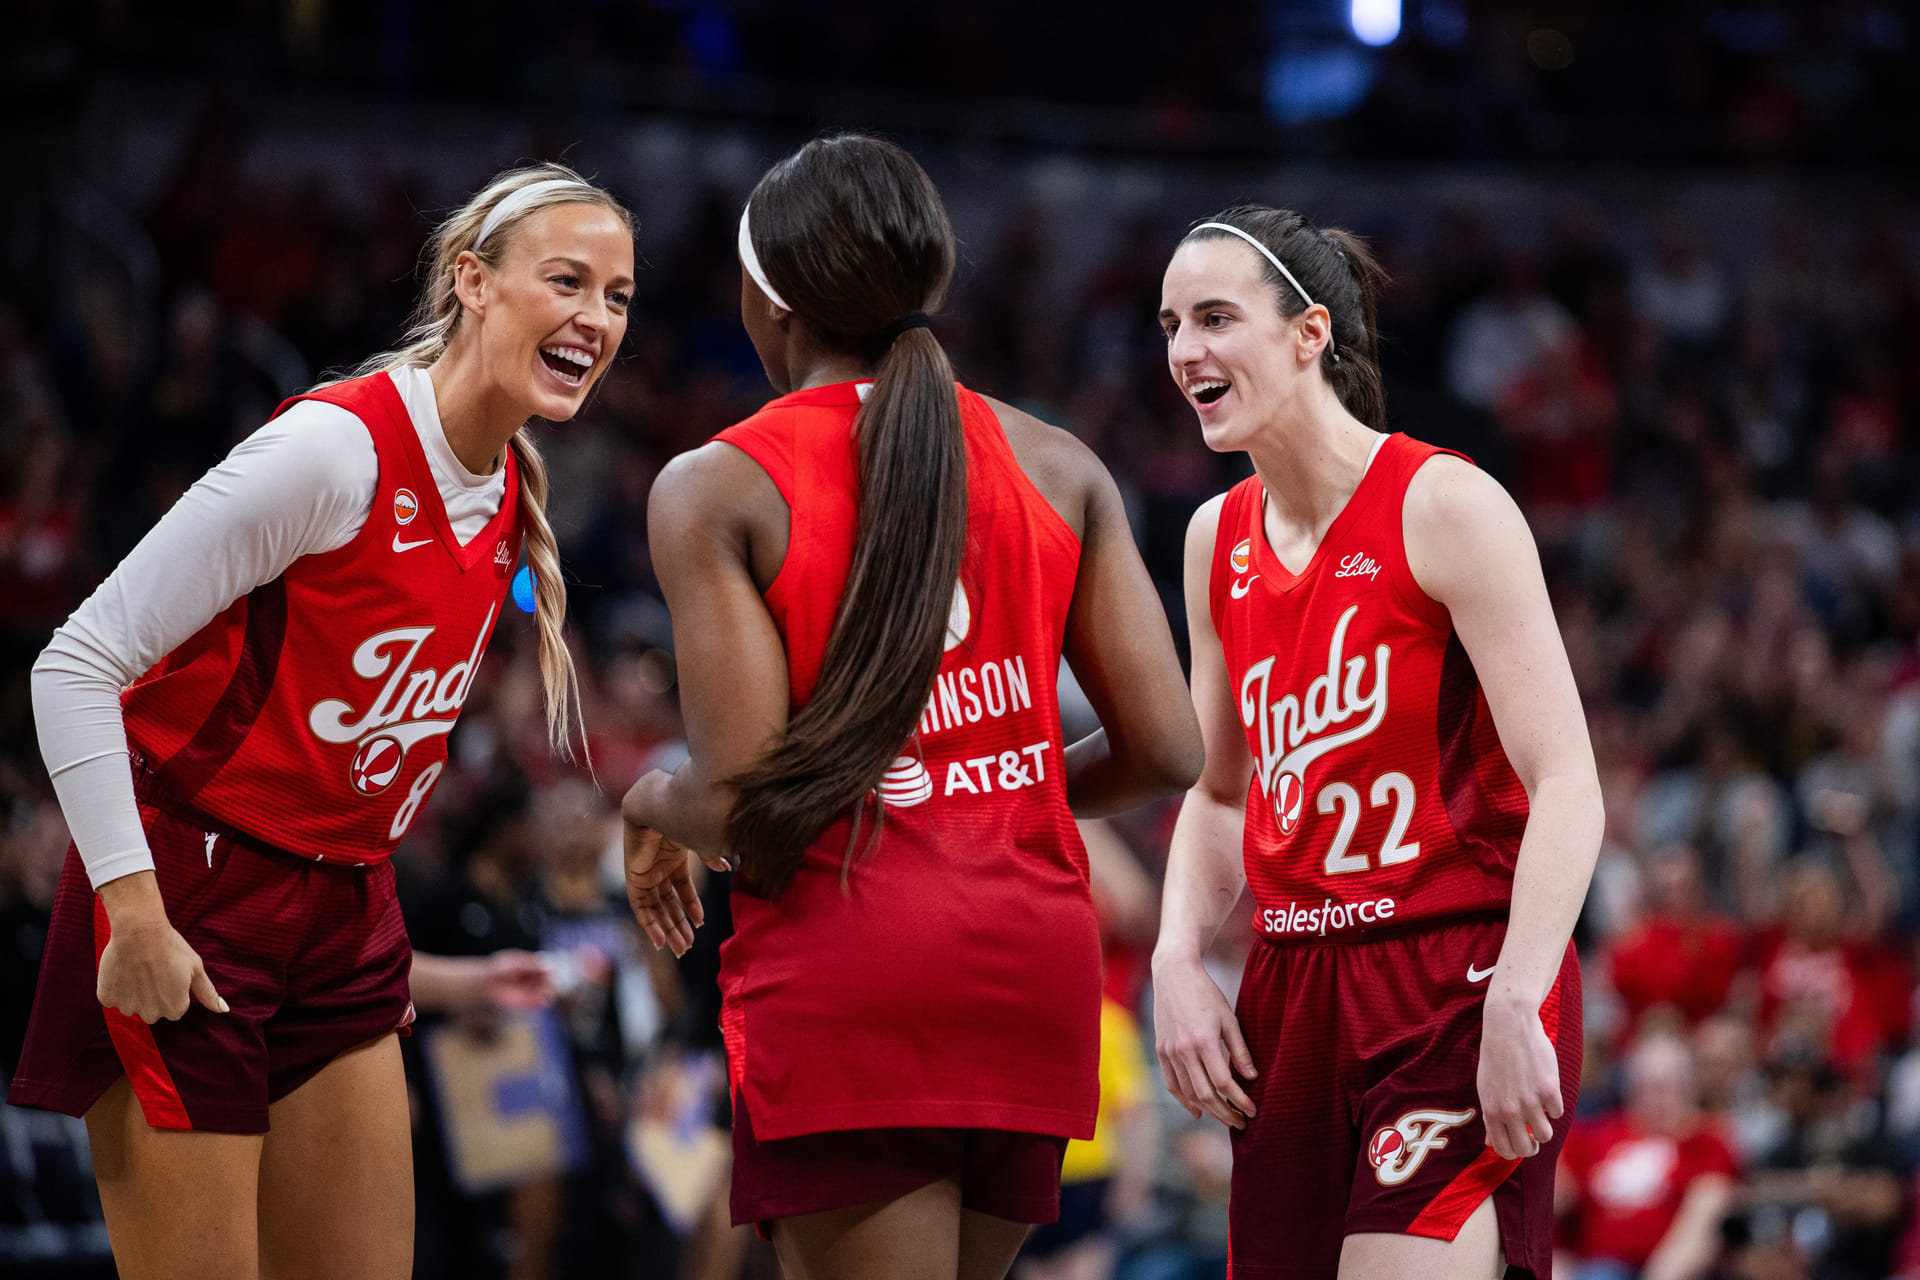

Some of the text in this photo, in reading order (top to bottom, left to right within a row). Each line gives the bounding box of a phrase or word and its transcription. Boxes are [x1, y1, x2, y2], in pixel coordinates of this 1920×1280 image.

[494, 540, 512, 573] Lilly
[1335, 552, 1381, 581] Lilly
[308, 600, 496, 755] Ind
[908, 655, 1032, 737] HNSON
[1241, 605, 1391, 798] Indy
[389, 760, 444, 840] 8
[944, 741, 1050, 796] AT&T
[1317, 772, 1420, 876] 22
[1264, 897, 1396, 936] salesforce
